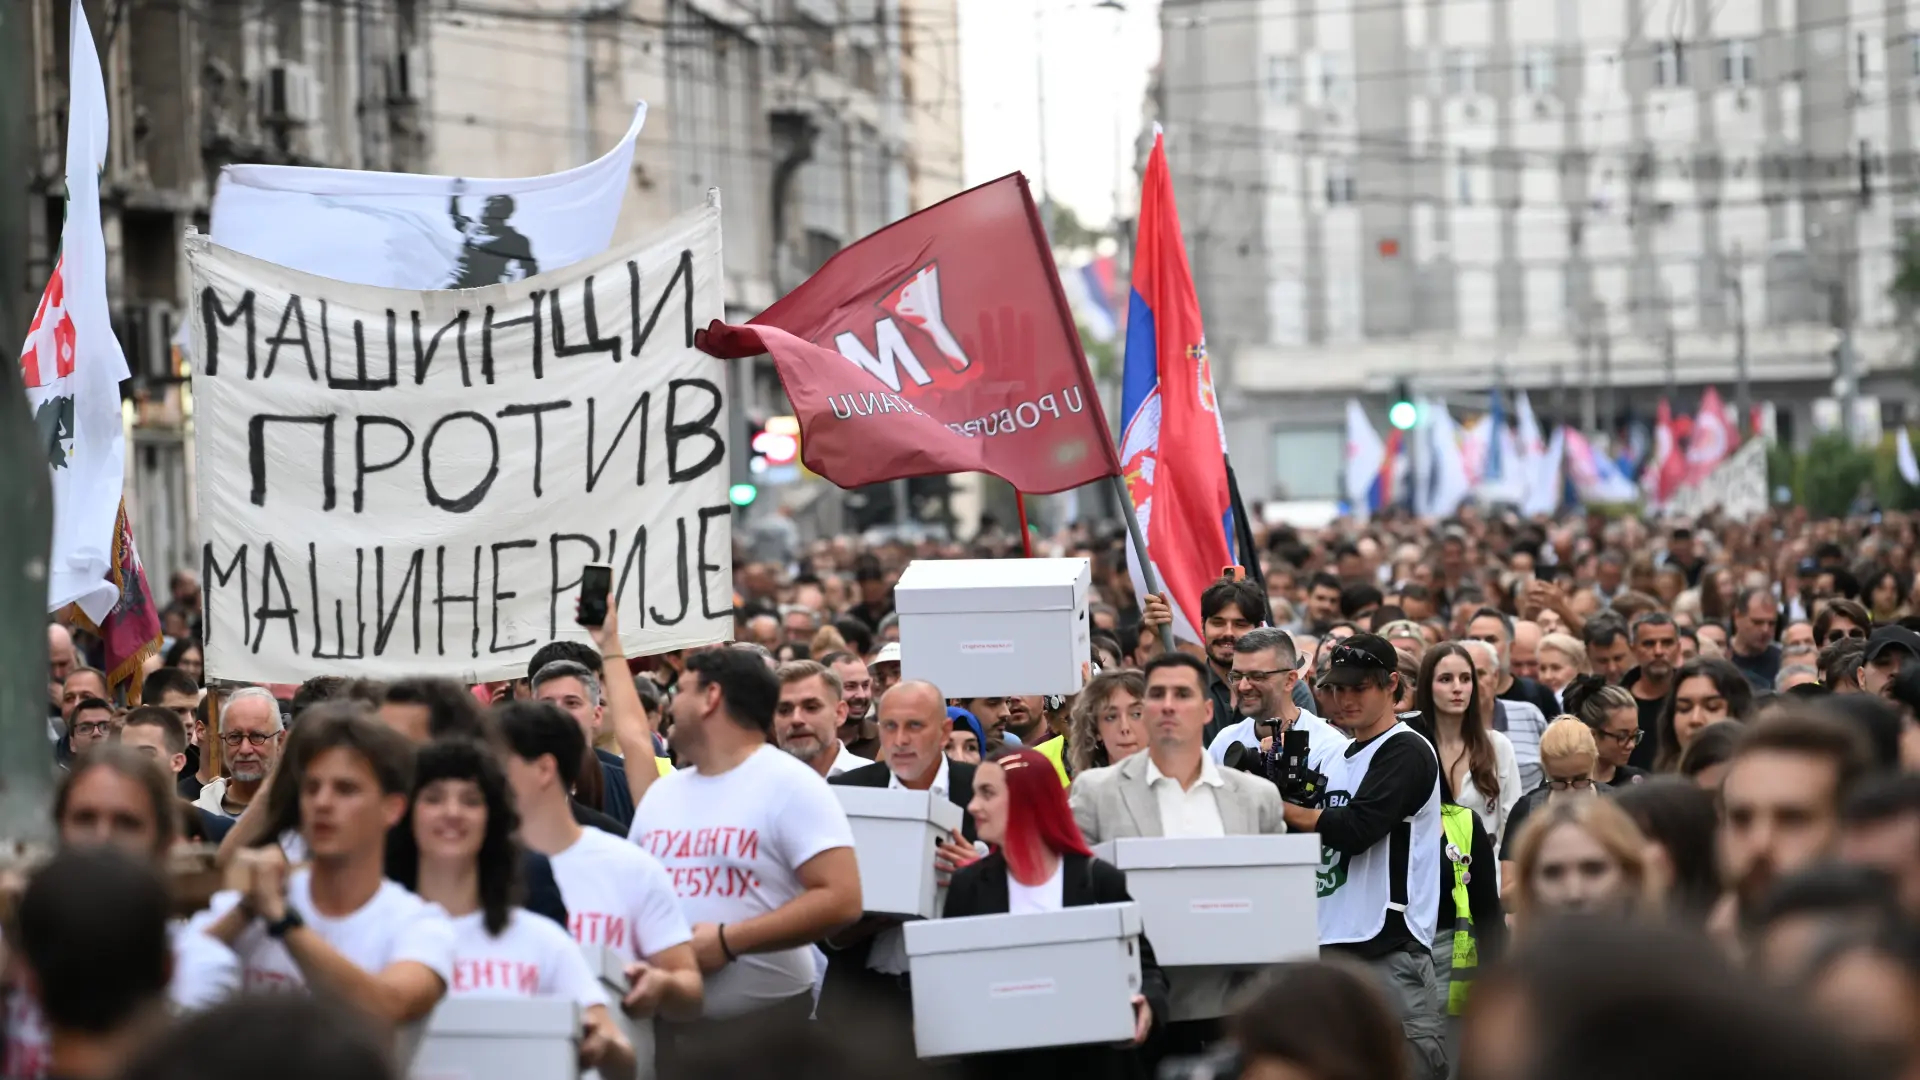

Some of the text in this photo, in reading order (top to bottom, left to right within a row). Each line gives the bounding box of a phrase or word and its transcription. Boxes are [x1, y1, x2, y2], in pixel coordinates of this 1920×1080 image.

[201, 249, 695, 392] МАШИНЦИ
[248, 378, 726, 513] ПРОТИВ
[203, 505, 733, 660] МАШИНЕРИЈЕ
